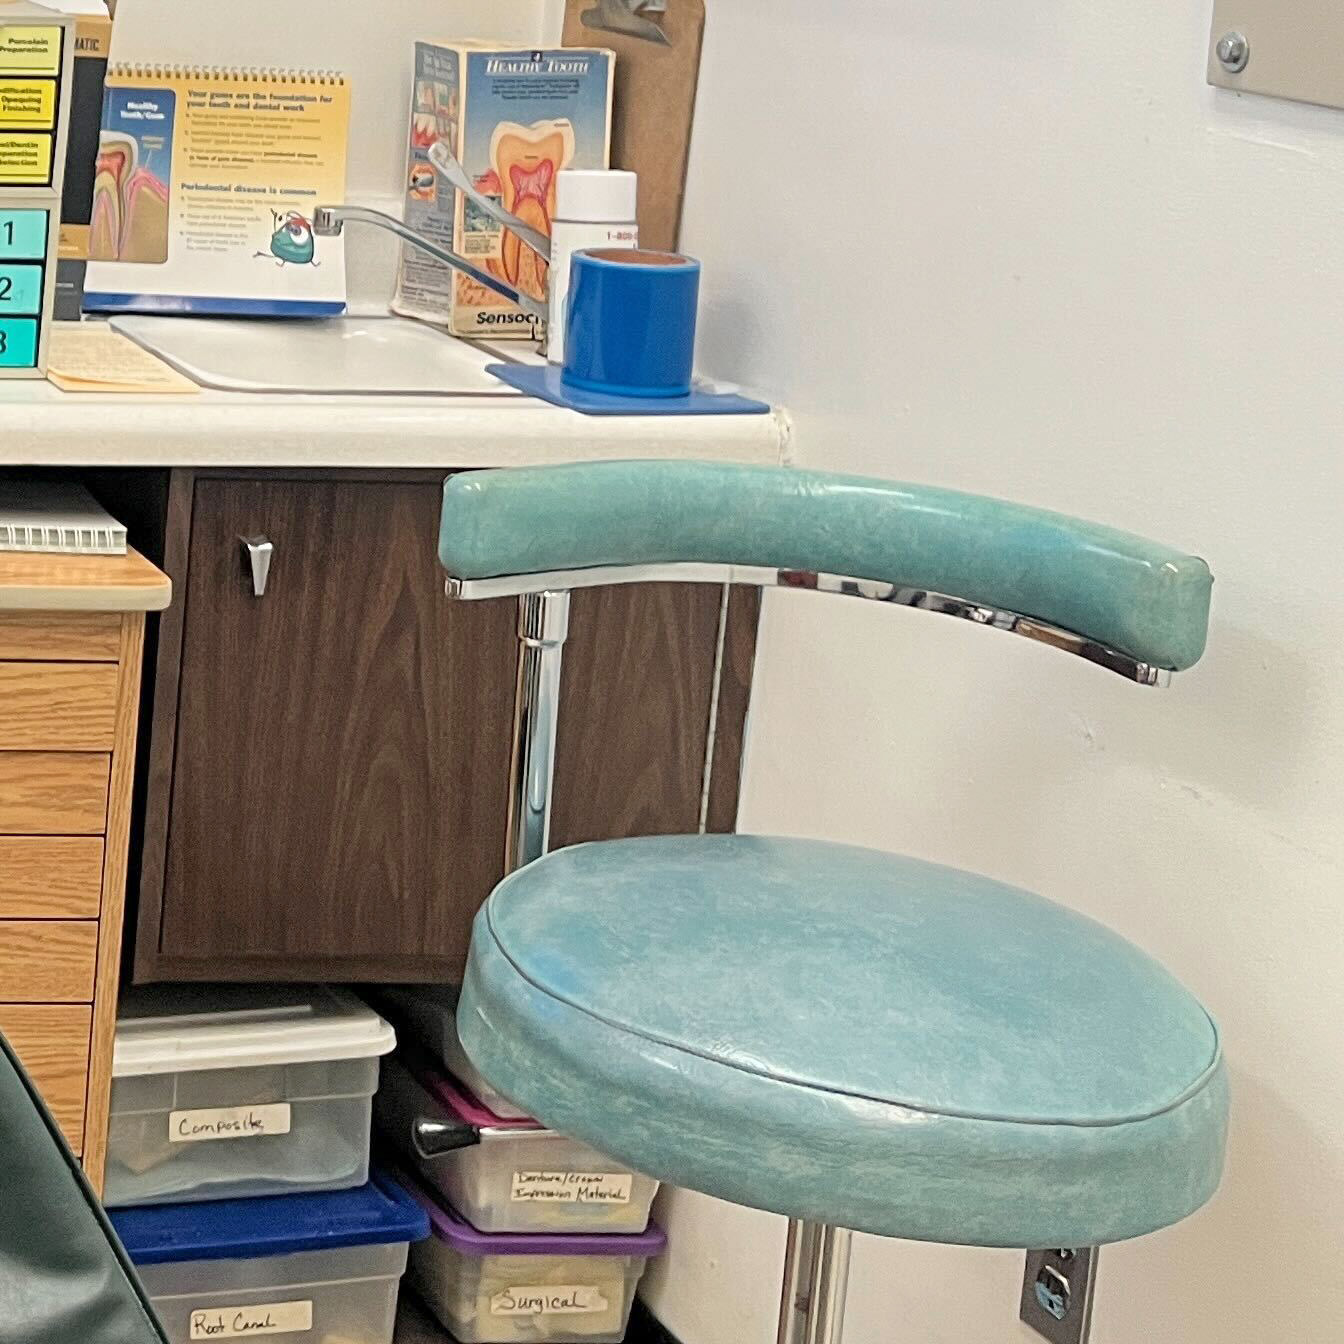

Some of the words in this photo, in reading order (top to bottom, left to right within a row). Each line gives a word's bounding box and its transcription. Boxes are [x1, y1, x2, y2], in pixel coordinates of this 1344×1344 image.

[486, 59, 541, 74] HEALTHY
[547, 59, 589, 74] TOOTH
[180, 182, 232, 193] Periodontal
[233, 184, 267, 194] disease
[2, 220, 14, 246] 1
[178, 1111, 265, 1136] Composite
[575, 1186, 627, 1202] Material
[496, 1289, 588, 1314] Surgical
[193, 1312, 225, 1335] Root
[232, 1311, 277, 1332] Canal
